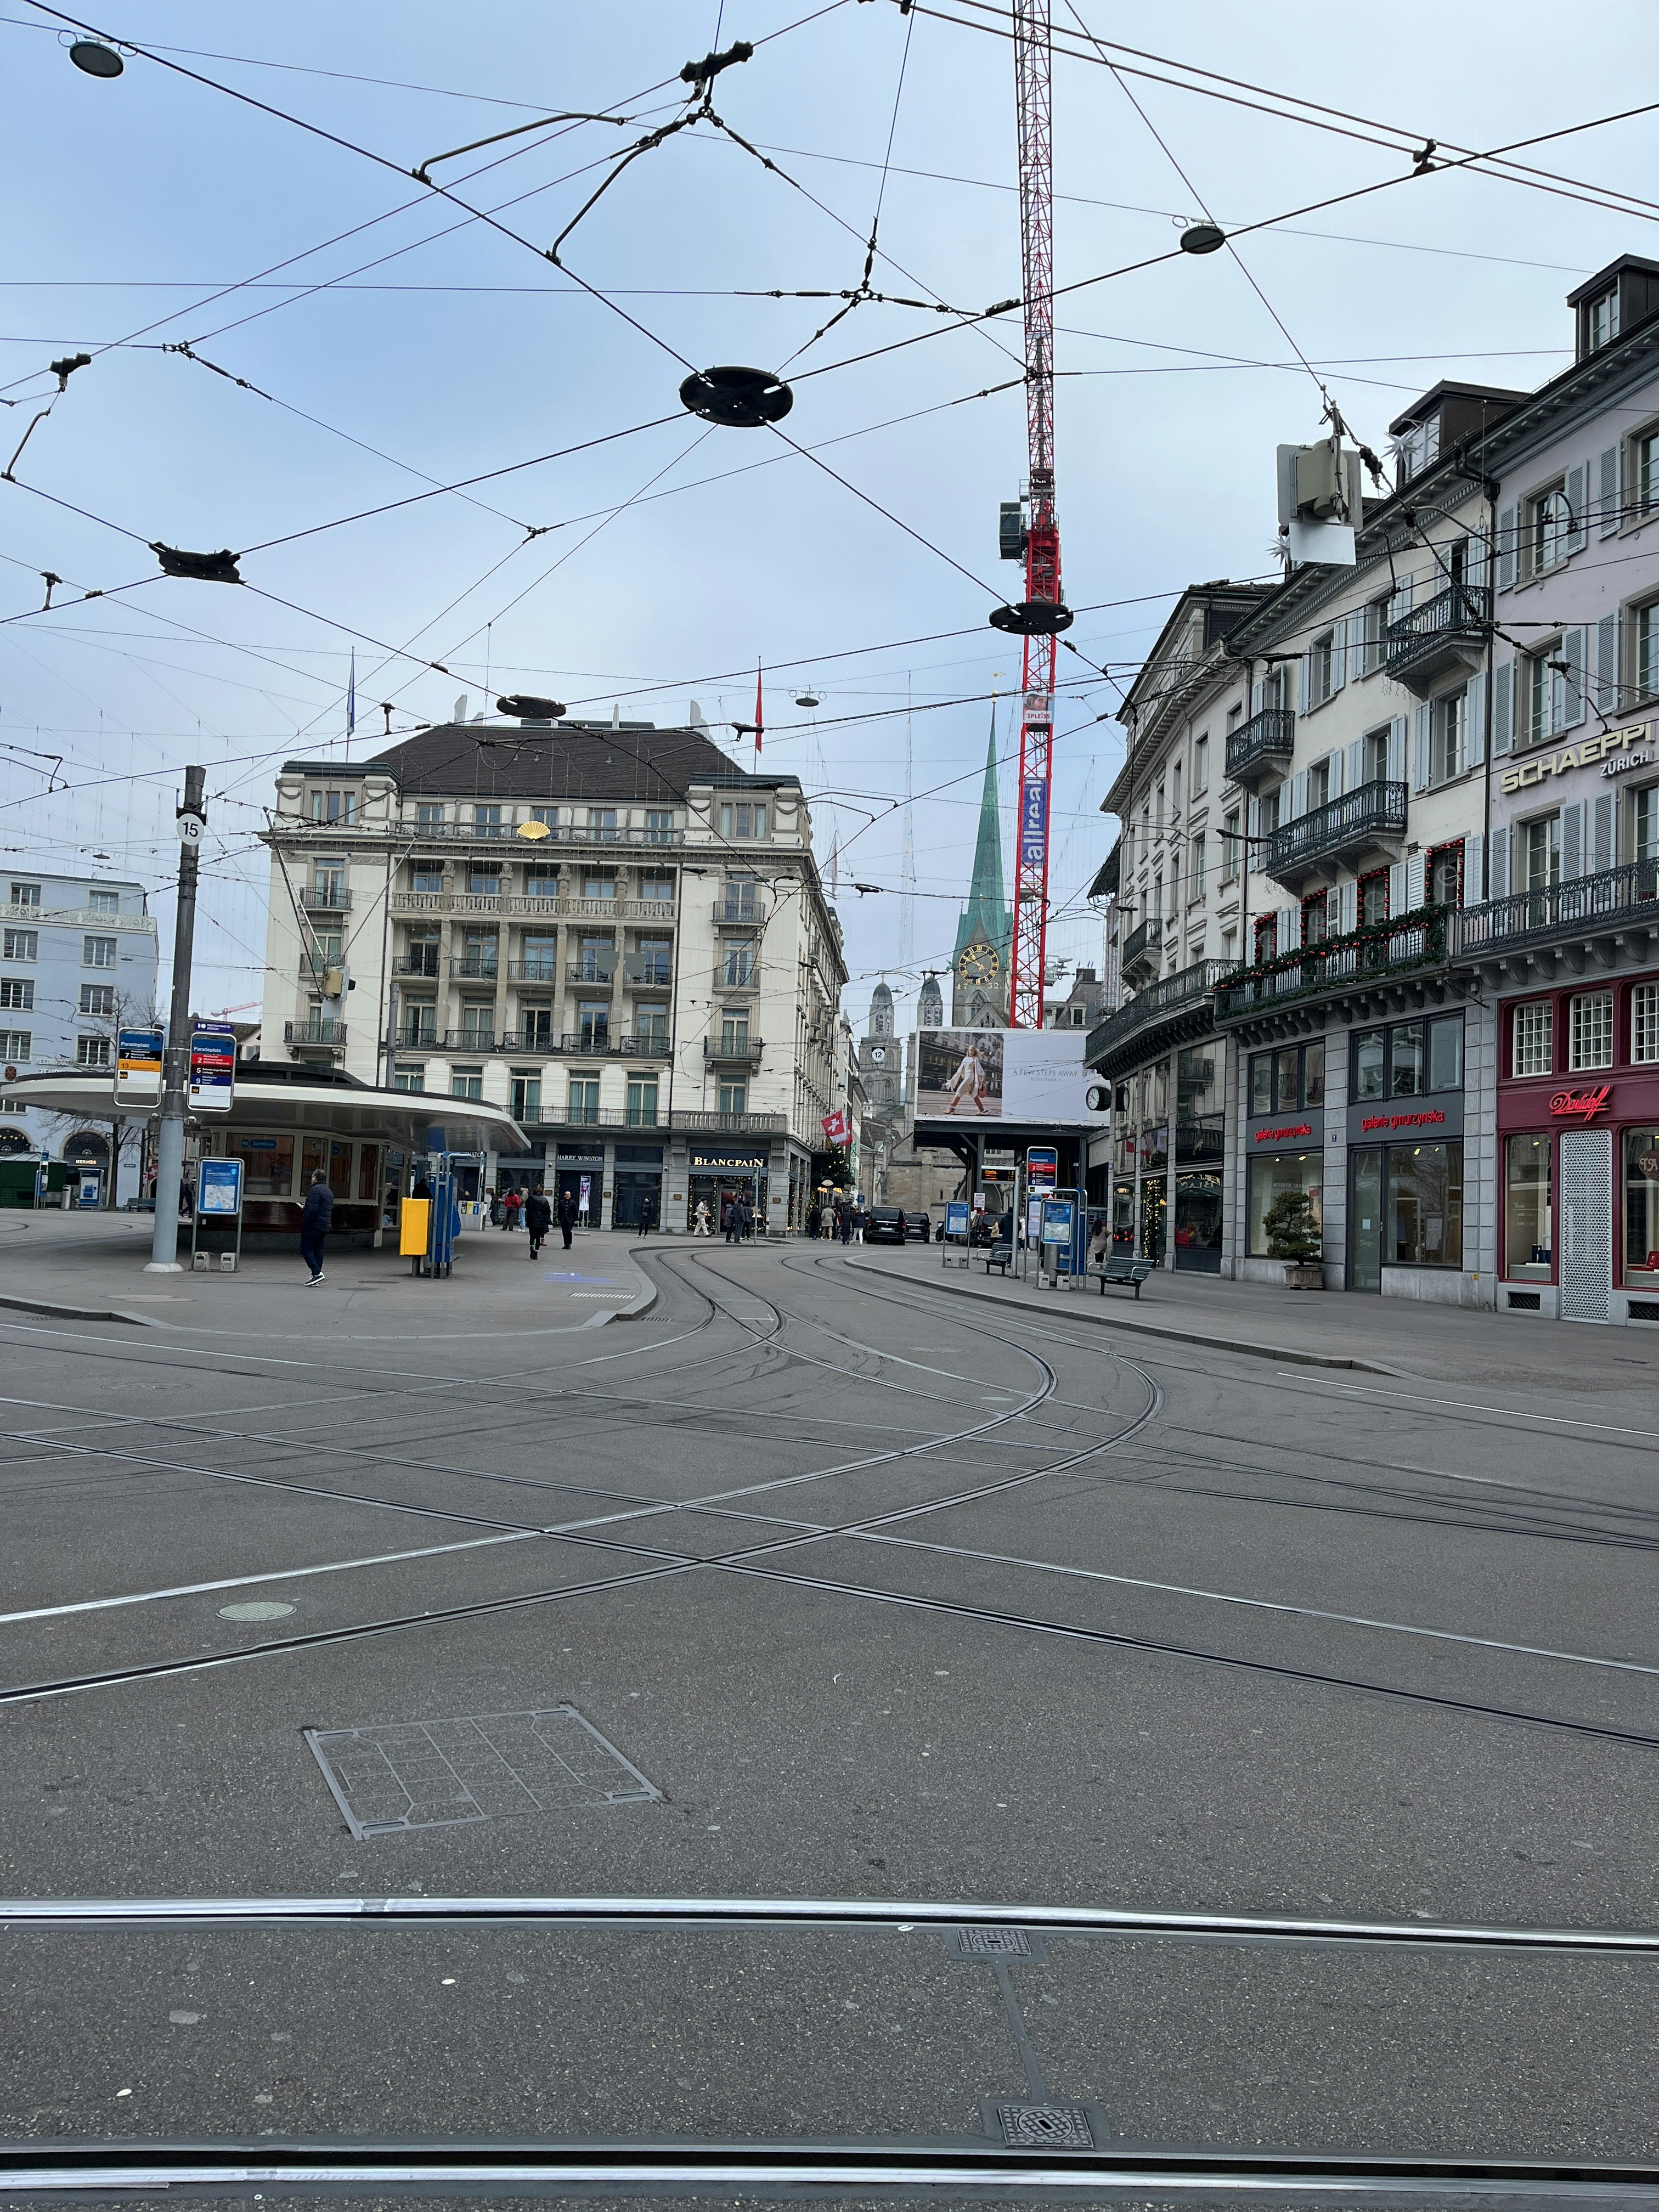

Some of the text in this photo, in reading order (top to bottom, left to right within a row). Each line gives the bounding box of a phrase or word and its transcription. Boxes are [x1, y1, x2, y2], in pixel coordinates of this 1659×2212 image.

[1500, 718, 1651, 794] SCHAEPPI
[182, 821, 198, 837] 15
[1023, 779, 1045, 860] allreal
[1549, 1085, 1611, 1122] Davidoff
[1361, 1109, 1444, 1132] galerie gmurzynska
[1255, 1123, 1312, 1143] galerie gmurzynska
[693, 1156, 764, 1167] BLANCPAIN
